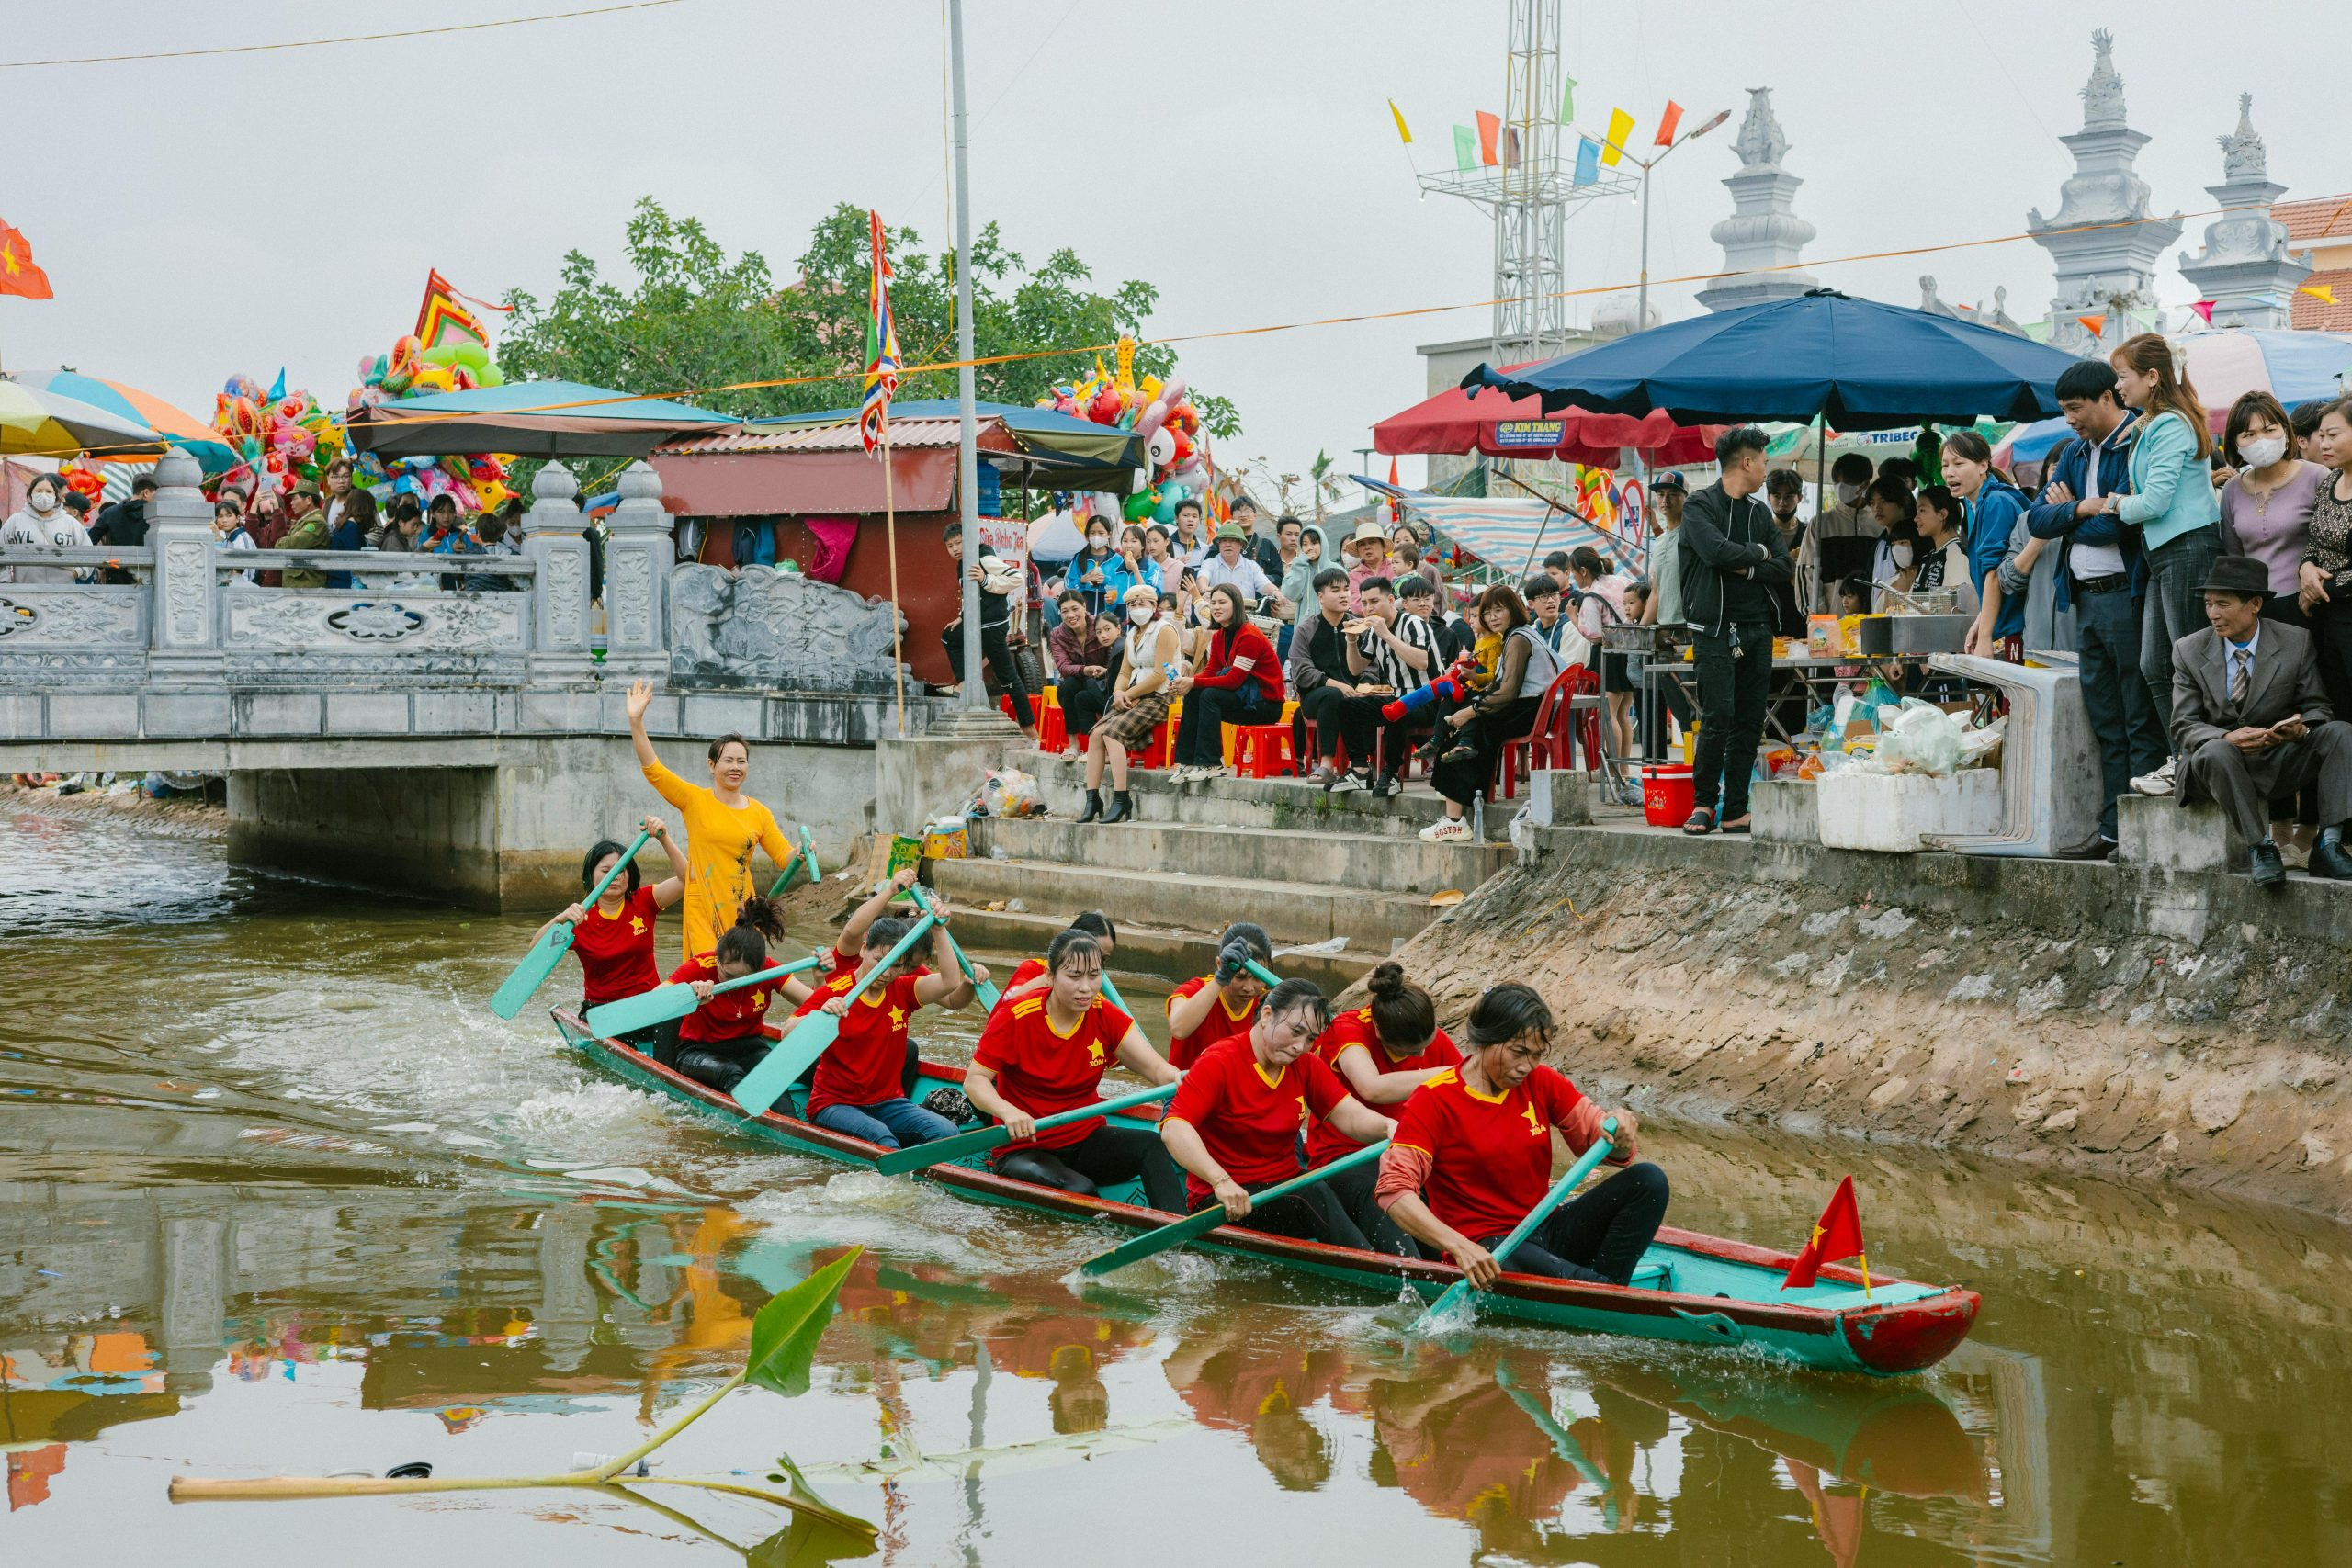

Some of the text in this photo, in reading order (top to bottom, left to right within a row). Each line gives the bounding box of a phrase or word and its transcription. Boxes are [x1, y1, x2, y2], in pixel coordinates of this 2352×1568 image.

[1514, 422, 1561, 433] KIM TRANG
[1871, 430, 1921, 444] TRIBEC
[2010, 643, 2018, 660] N
[1089, 1058, 1104, 1067] XÓM
